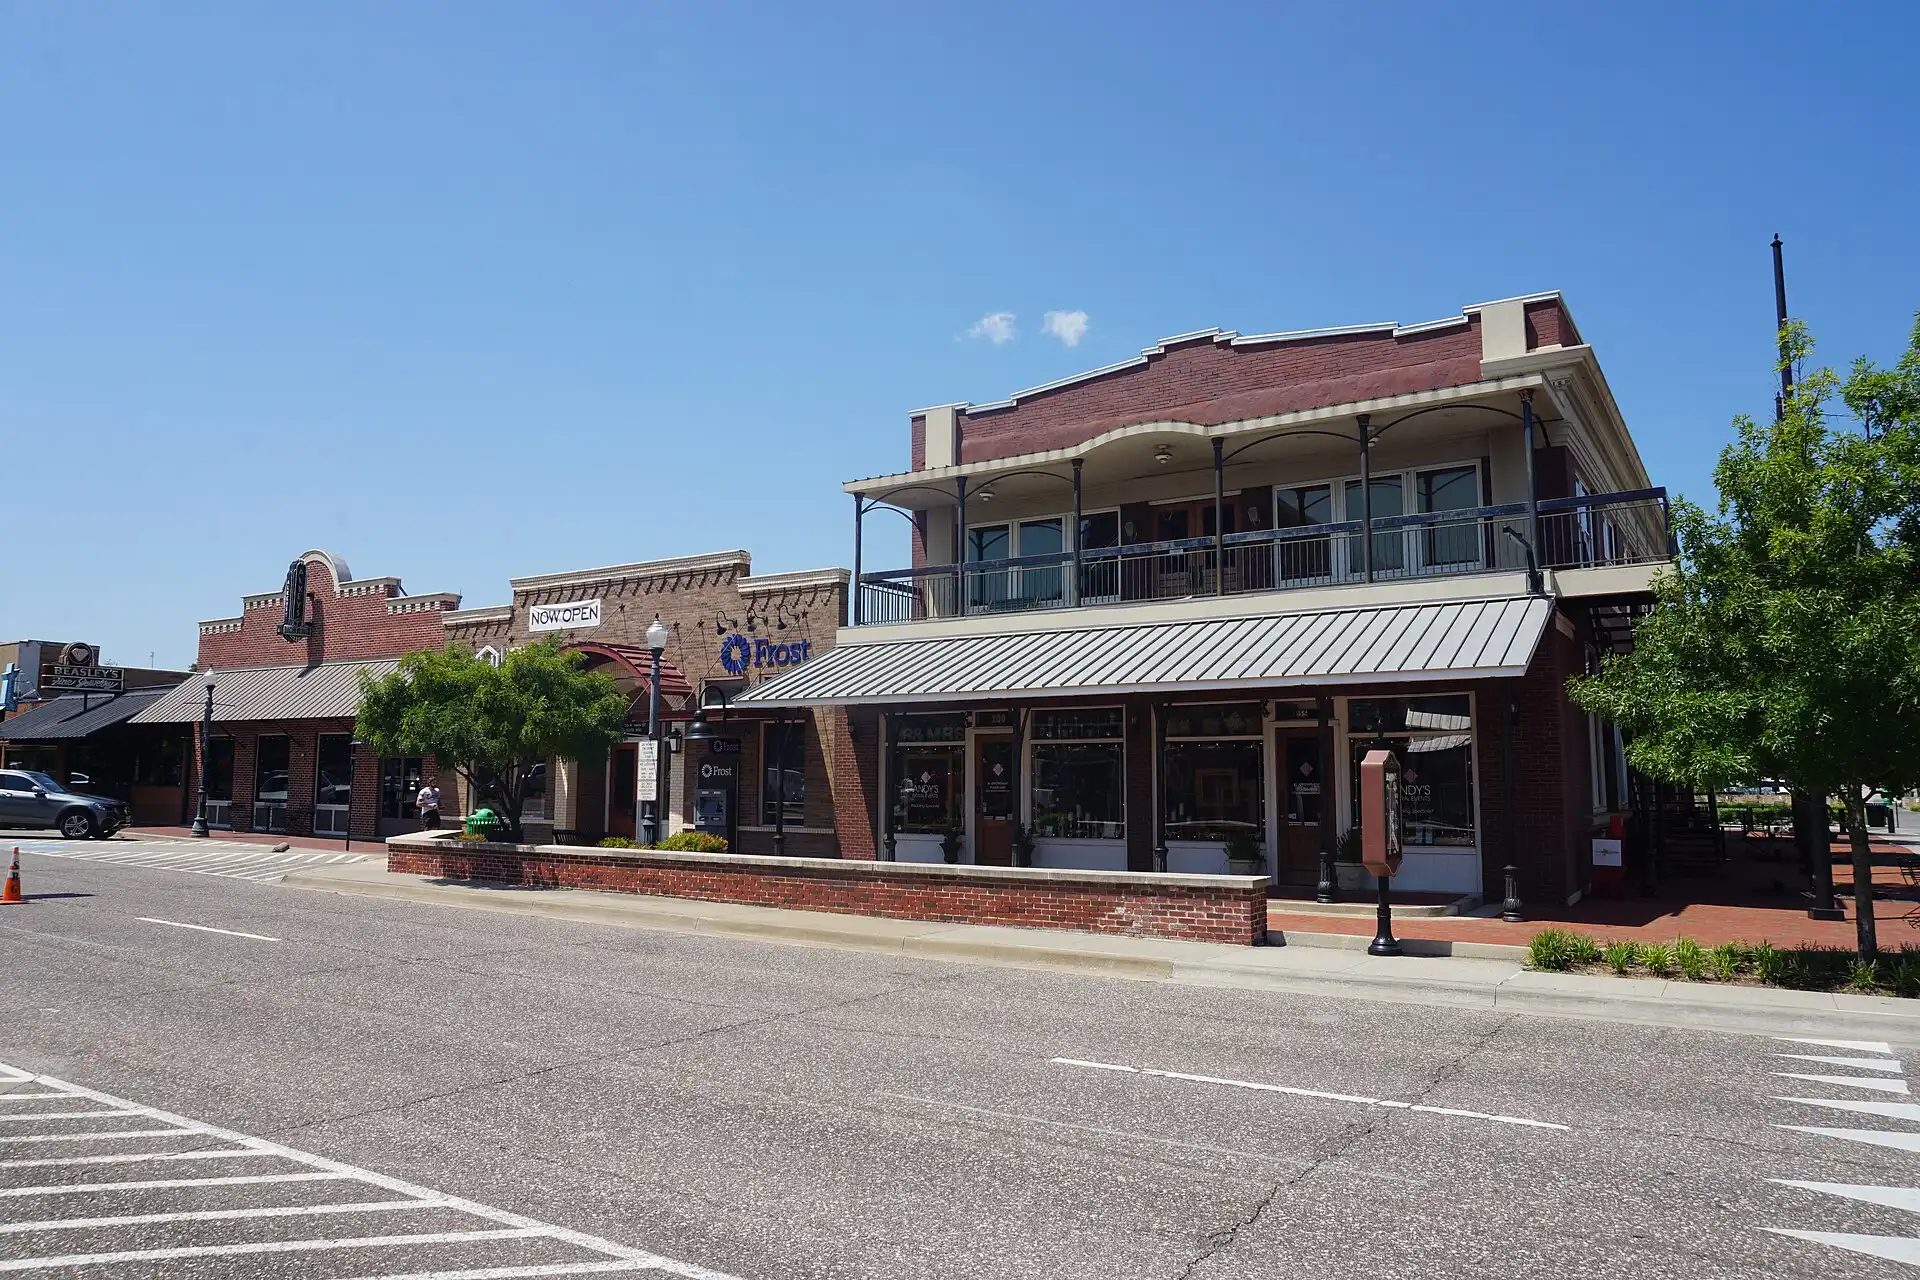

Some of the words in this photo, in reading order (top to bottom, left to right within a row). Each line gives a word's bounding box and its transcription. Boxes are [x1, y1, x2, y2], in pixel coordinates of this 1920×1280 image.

[531, 610, 561, 626] NOW
[562, 606, 599, 623] OPEN
[753, 638, 810, 666] Frost
[53, 666, 119, 679] BEASLEY'S
[723, 741, 740, 751] Frost
[713, 765, 732, 776] Frost
